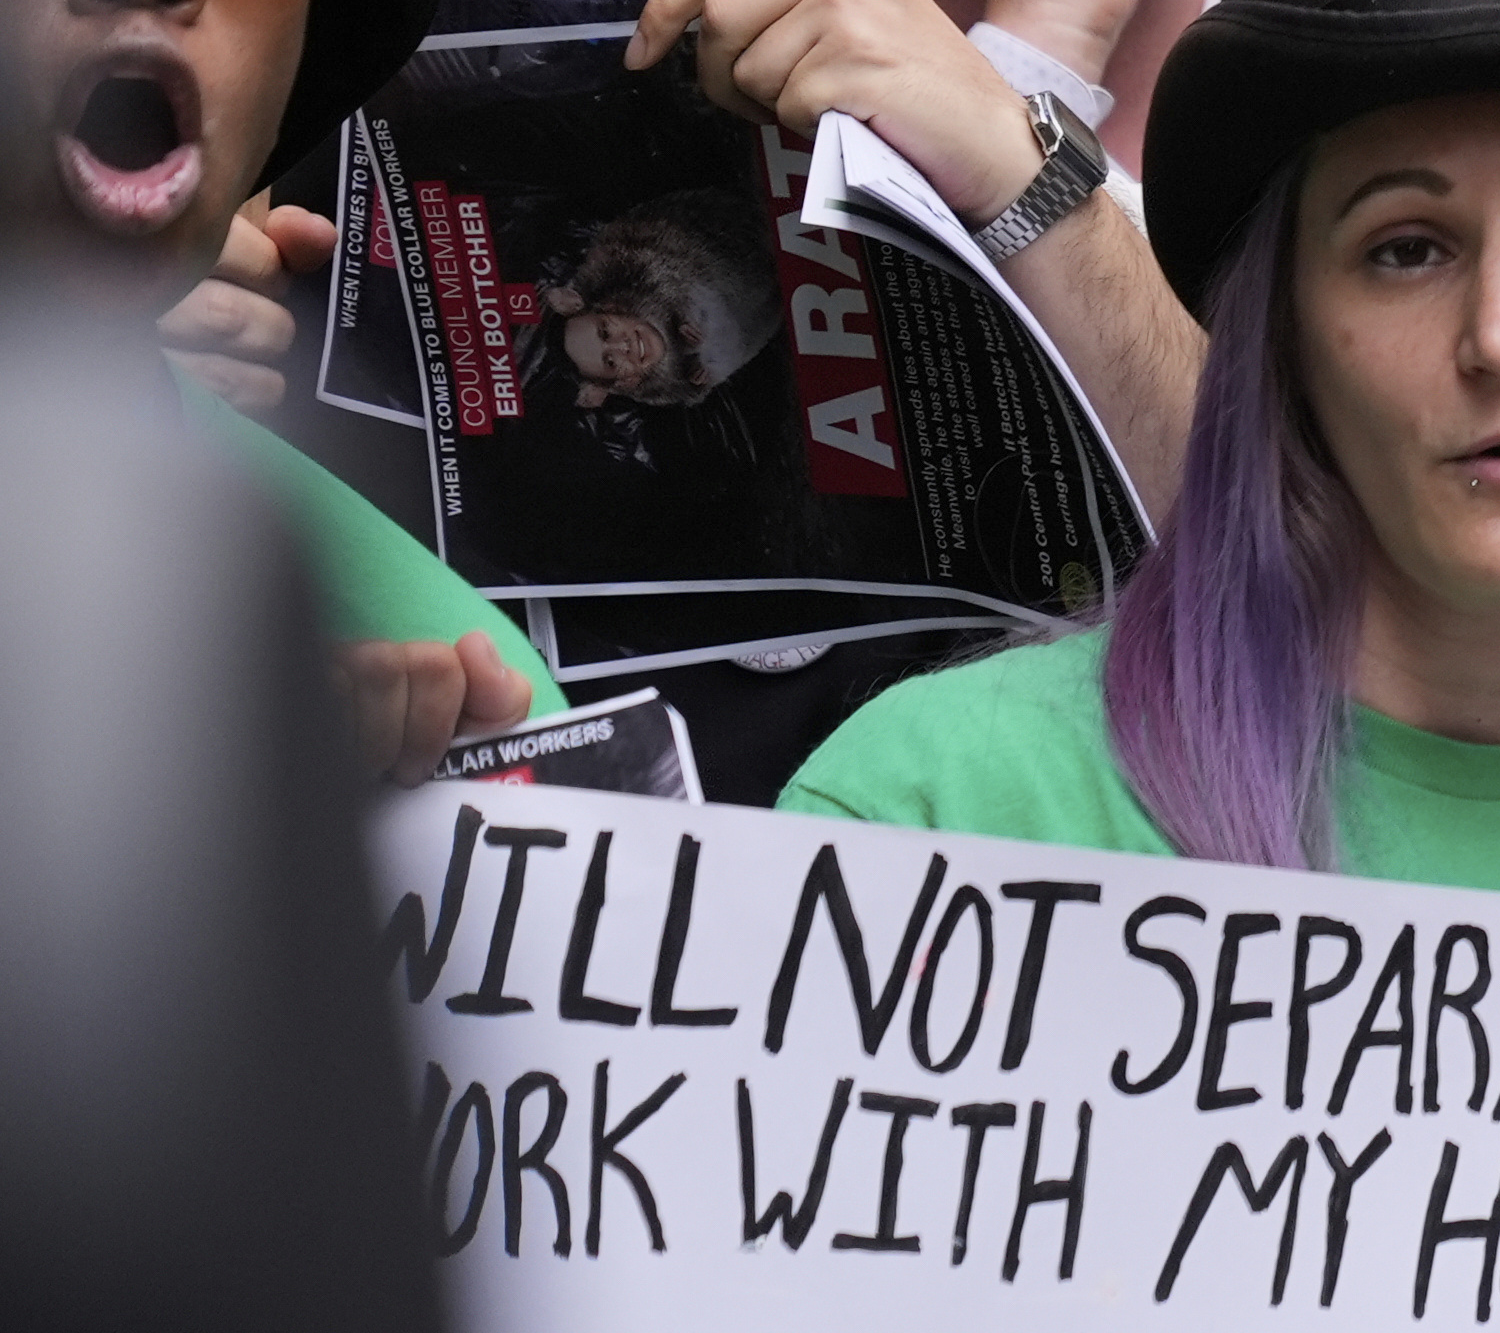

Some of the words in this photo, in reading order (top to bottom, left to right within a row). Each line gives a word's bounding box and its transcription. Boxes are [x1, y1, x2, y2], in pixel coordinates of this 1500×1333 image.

[372, 118, 409, 204] WORKERS
[397, 208, 426, 279] COLLAR
[420, 187, 463, 299] MEMBER
[458, 201, 507, 347] BOTTCHER
[413, 282, 436, 328] BLUE
[509, 294, 533, 316] IS
[425, 332, 441, 359] TO
[447, 306, 486, 427] COUNCIL
[430, 361, 454, 431] COMES
[489, 353, 519, 417] ERIK
[440, 434, 456, 453] IT
[807, 385, 896, 470] A
[442, 457, 463, 517] WHEN
[497, 717, 615, 764] WORKERS
[763, 842, 1102, 1075] NOT
[422, 1058, 687, 1260] ORK
[736, 1076, 1092, 1284] WITH
[1155, 1127, 1391, 1309] MY
